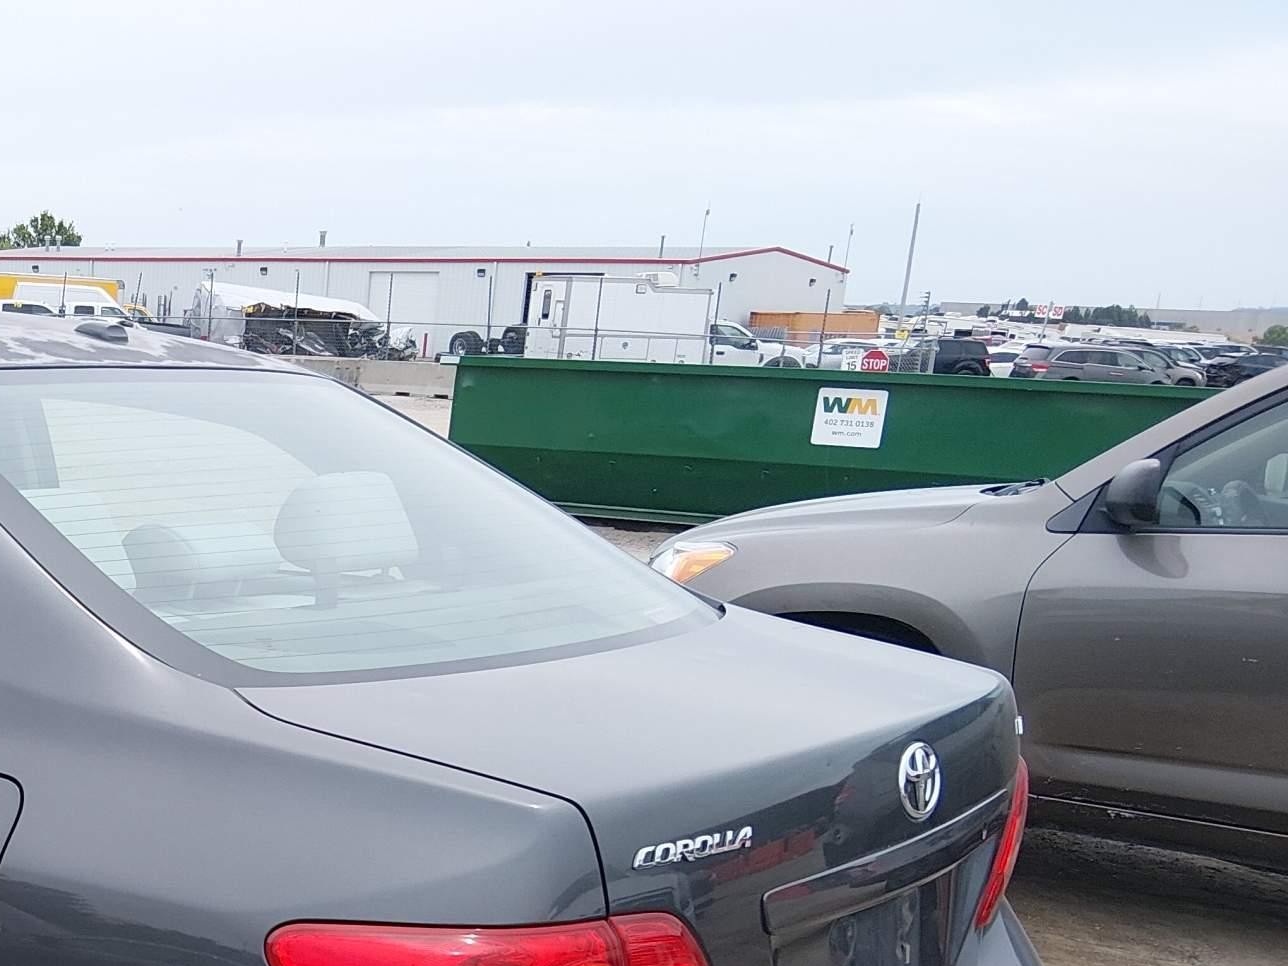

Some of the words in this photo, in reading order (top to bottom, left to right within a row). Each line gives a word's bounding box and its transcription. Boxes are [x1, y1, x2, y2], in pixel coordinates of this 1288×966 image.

[847, 361, 857, 371] 15
[862, 359, 887, 370] STOP
[823, 396, 878, 416] WM
[840, 420, 853, 428] 731
[632, 826, 753, 869] COROLLA
